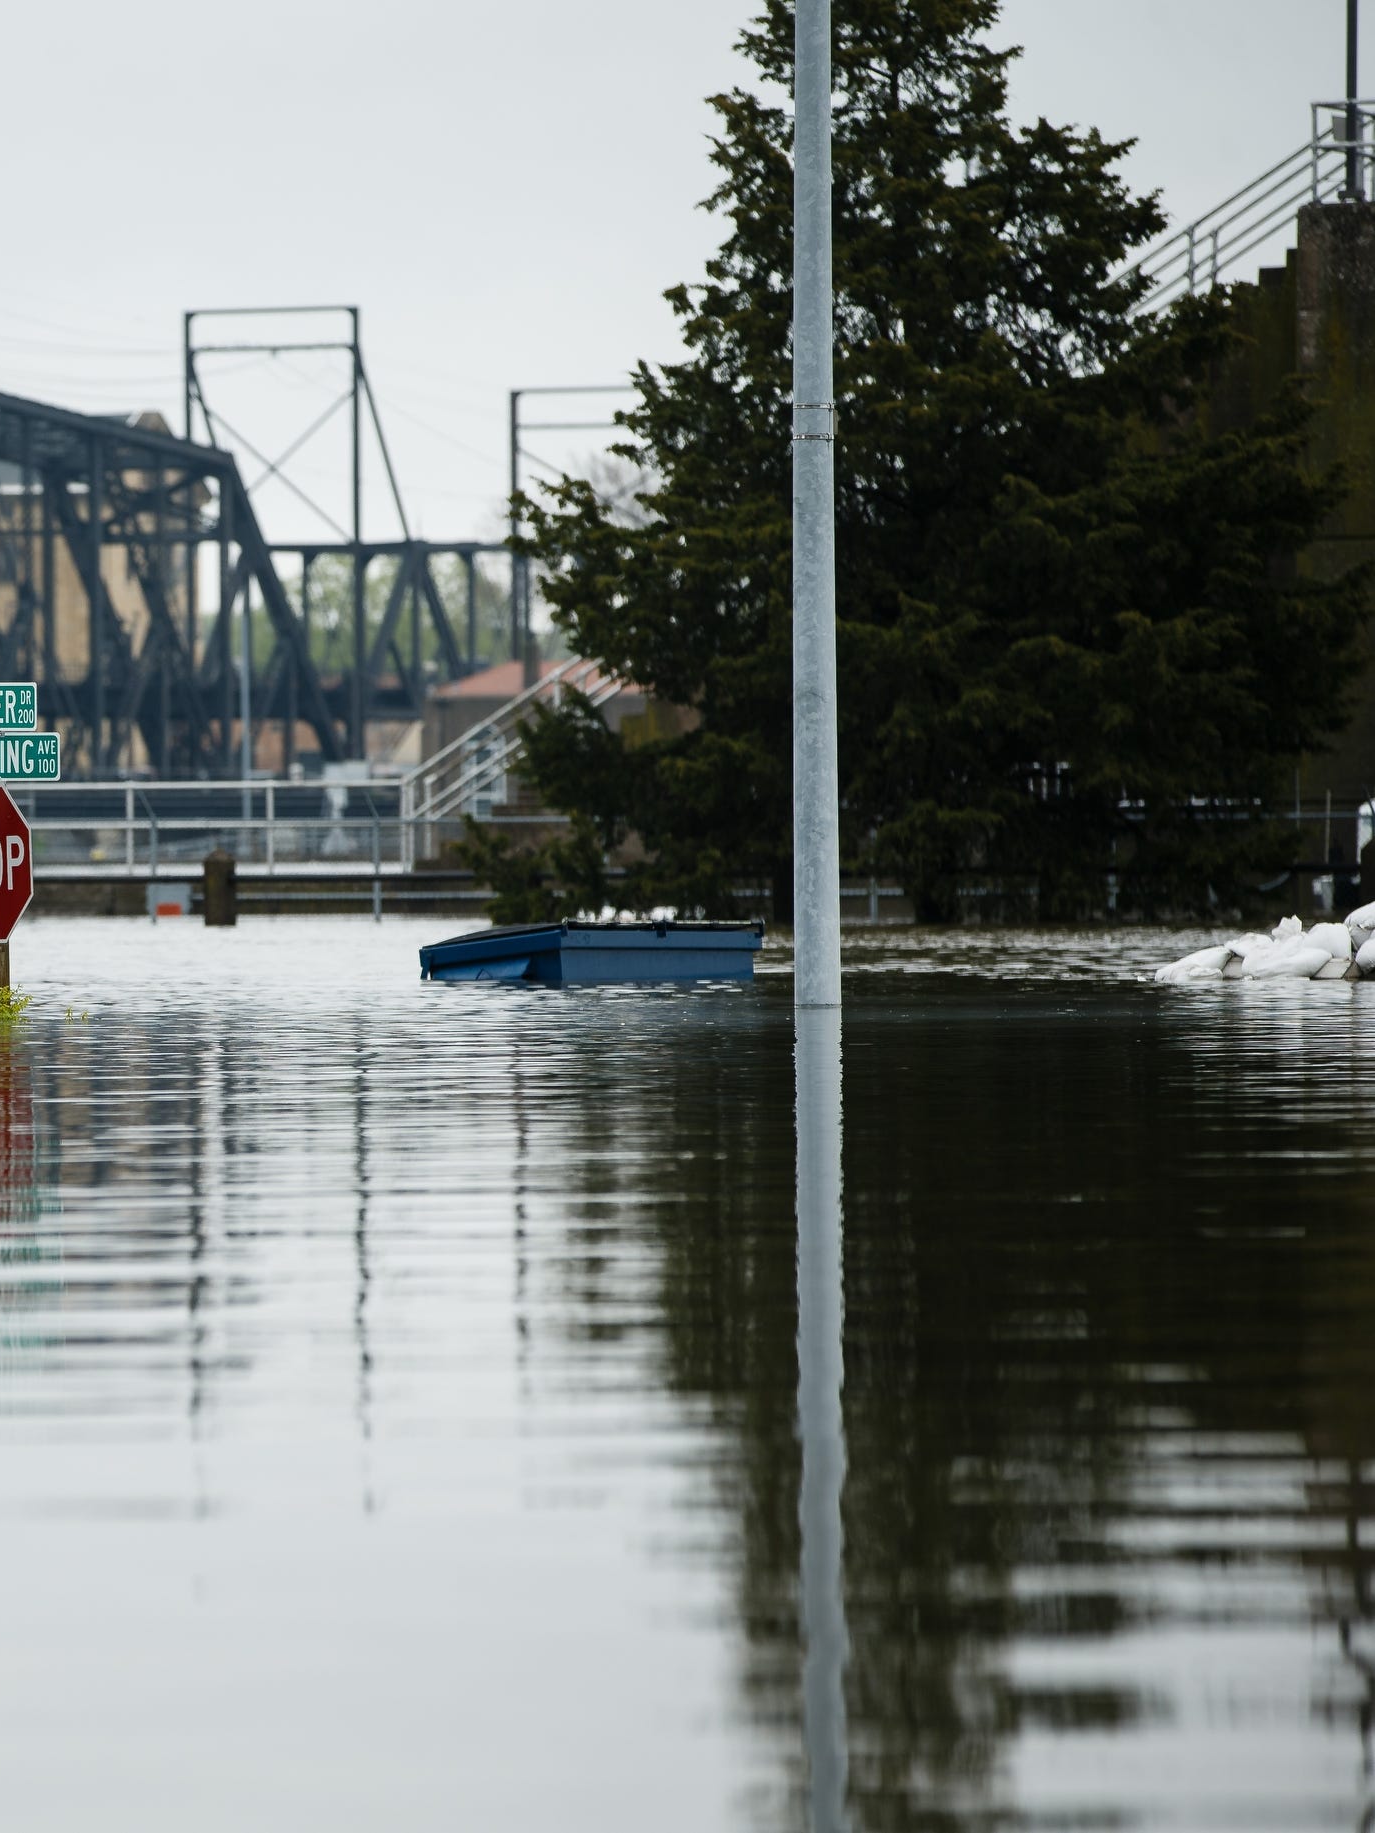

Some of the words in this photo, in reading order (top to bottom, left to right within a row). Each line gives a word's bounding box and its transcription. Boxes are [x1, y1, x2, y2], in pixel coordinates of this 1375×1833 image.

[20, 690, 32, 705] DR
[18, 709, 34, 724] 200
[37, 740, 56, 755] AVE
[38, 758, 56, 774] 100
